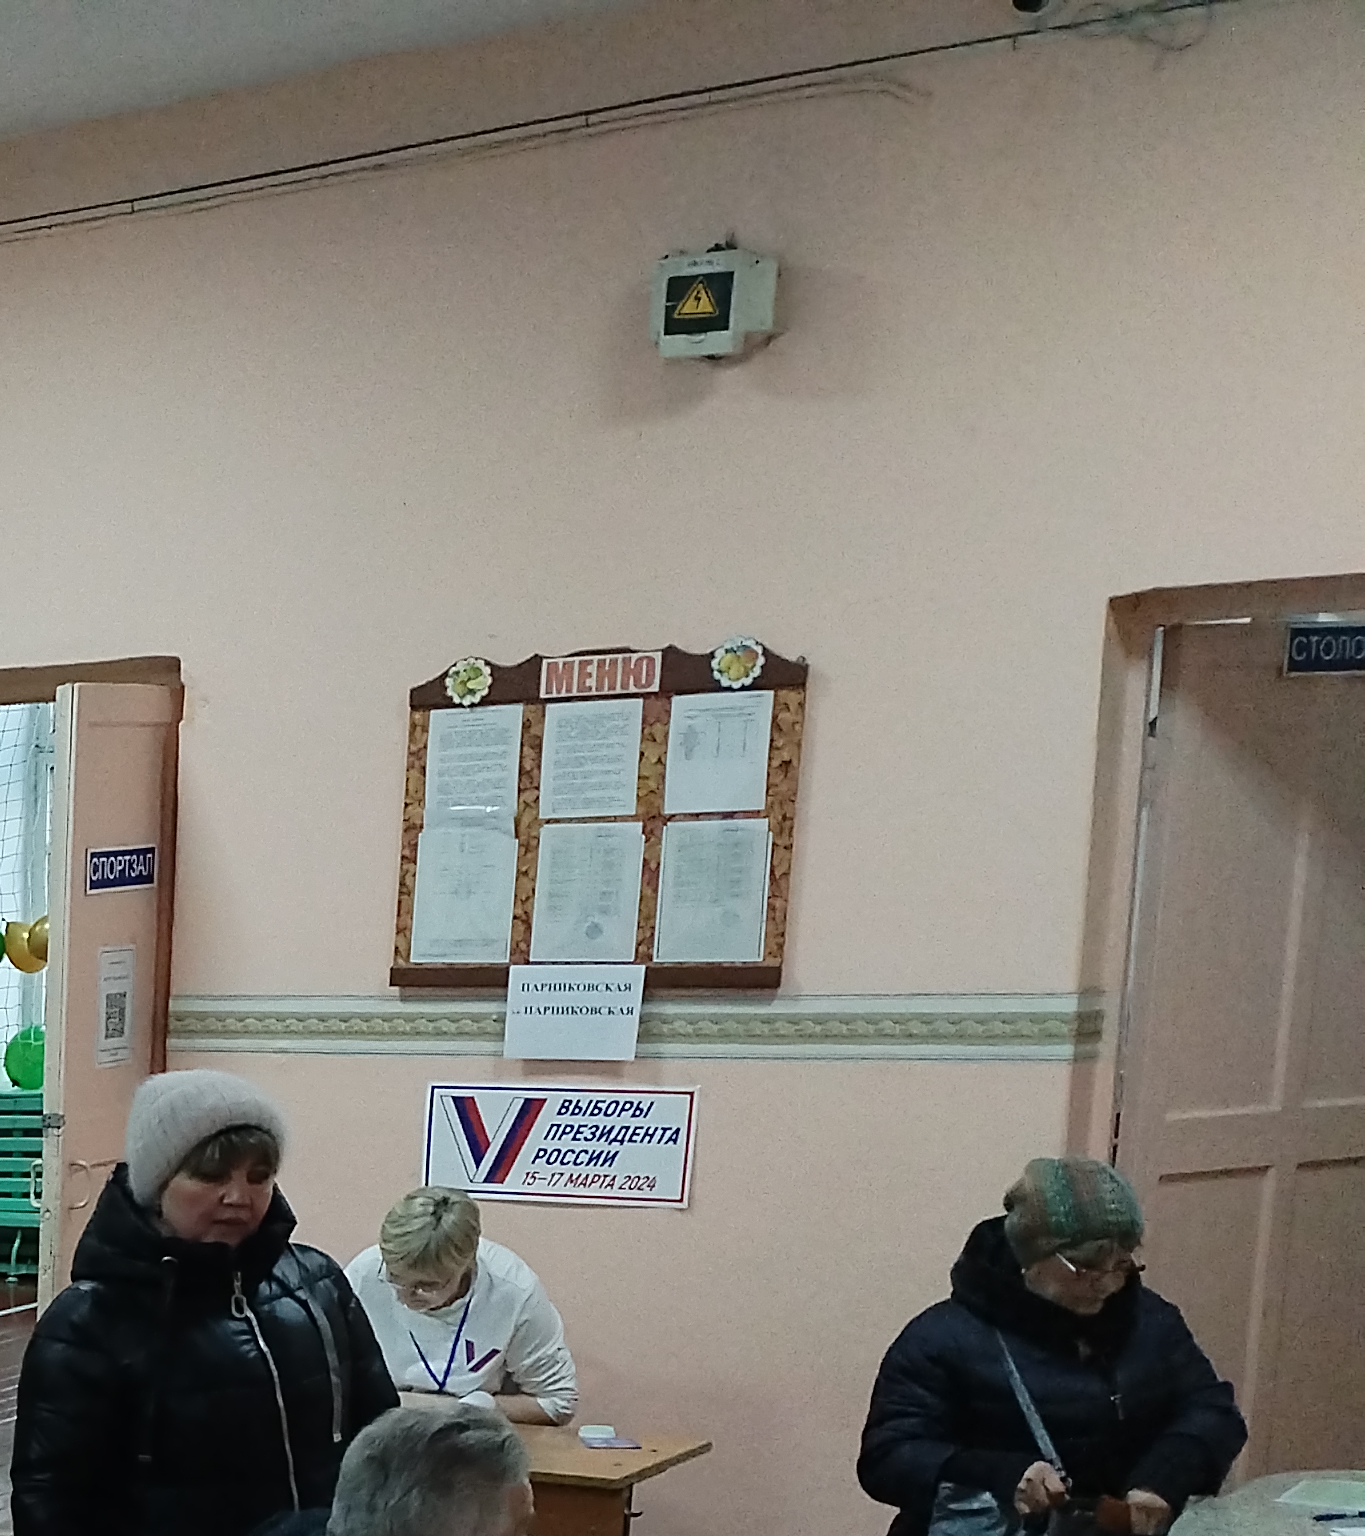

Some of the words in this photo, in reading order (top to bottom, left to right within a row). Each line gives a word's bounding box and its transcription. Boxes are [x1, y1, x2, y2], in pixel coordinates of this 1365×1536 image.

[544, 654, 658, 696] МЕНЮ
[89, 853, 154, 881] СПОРТЗАЛ
[520, 981, 633, 993] ПАРНИКОВСКАЯ
[523, 1005, 635, 1017] ПАРНИКОВСКАЯ
[556, 1099, 655, 1119] ВЫБОРЫ
[542, 1123, 682, 1146] ПРЕЗИДЕНТА
[531, 1148, 621, 1168] РОССИИ
[564, 1172, 618, 1189] МАРТА
[618, 1174, 658, 1192] 2024
